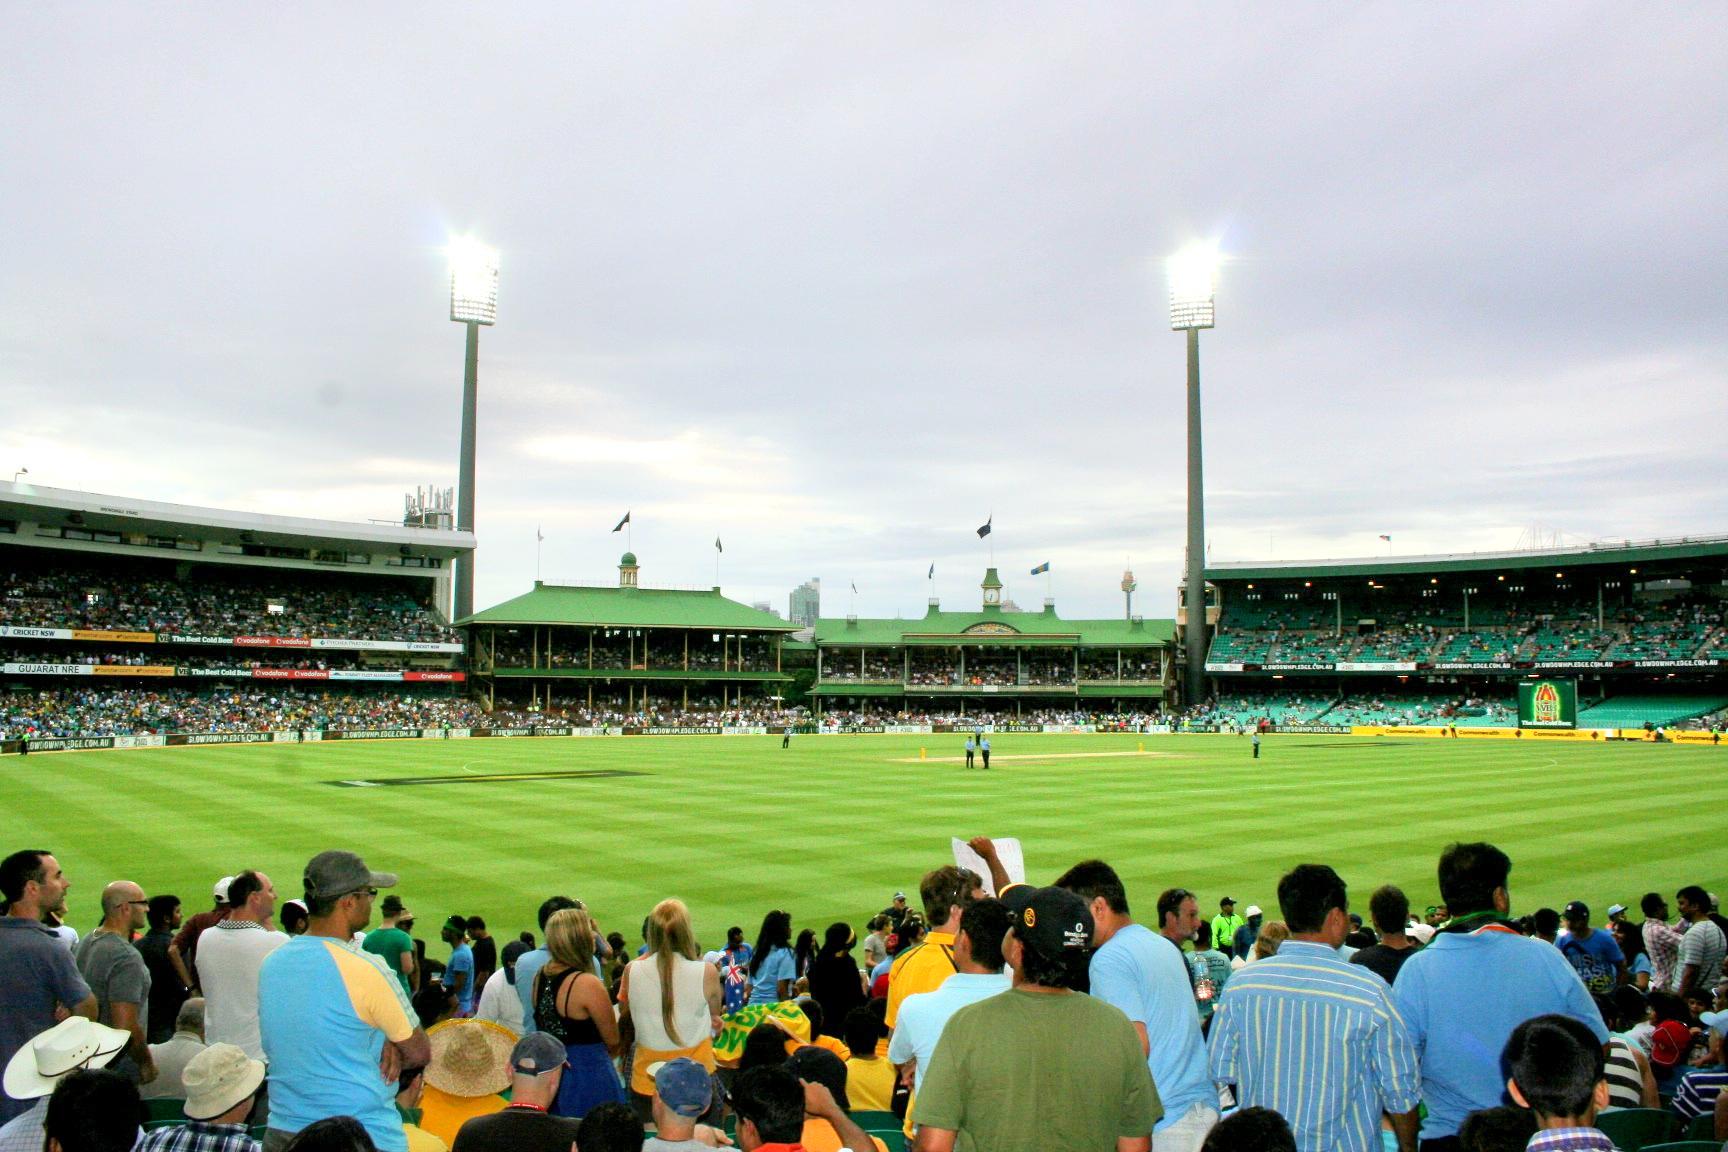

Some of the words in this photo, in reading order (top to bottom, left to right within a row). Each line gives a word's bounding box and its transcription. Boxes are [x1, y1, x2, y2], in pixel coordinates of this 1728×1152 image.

[18, 664, 59, 673] GUJARAT
[62, 665, 80, 674] NRE
[221, 668, 236, 676] Cold
